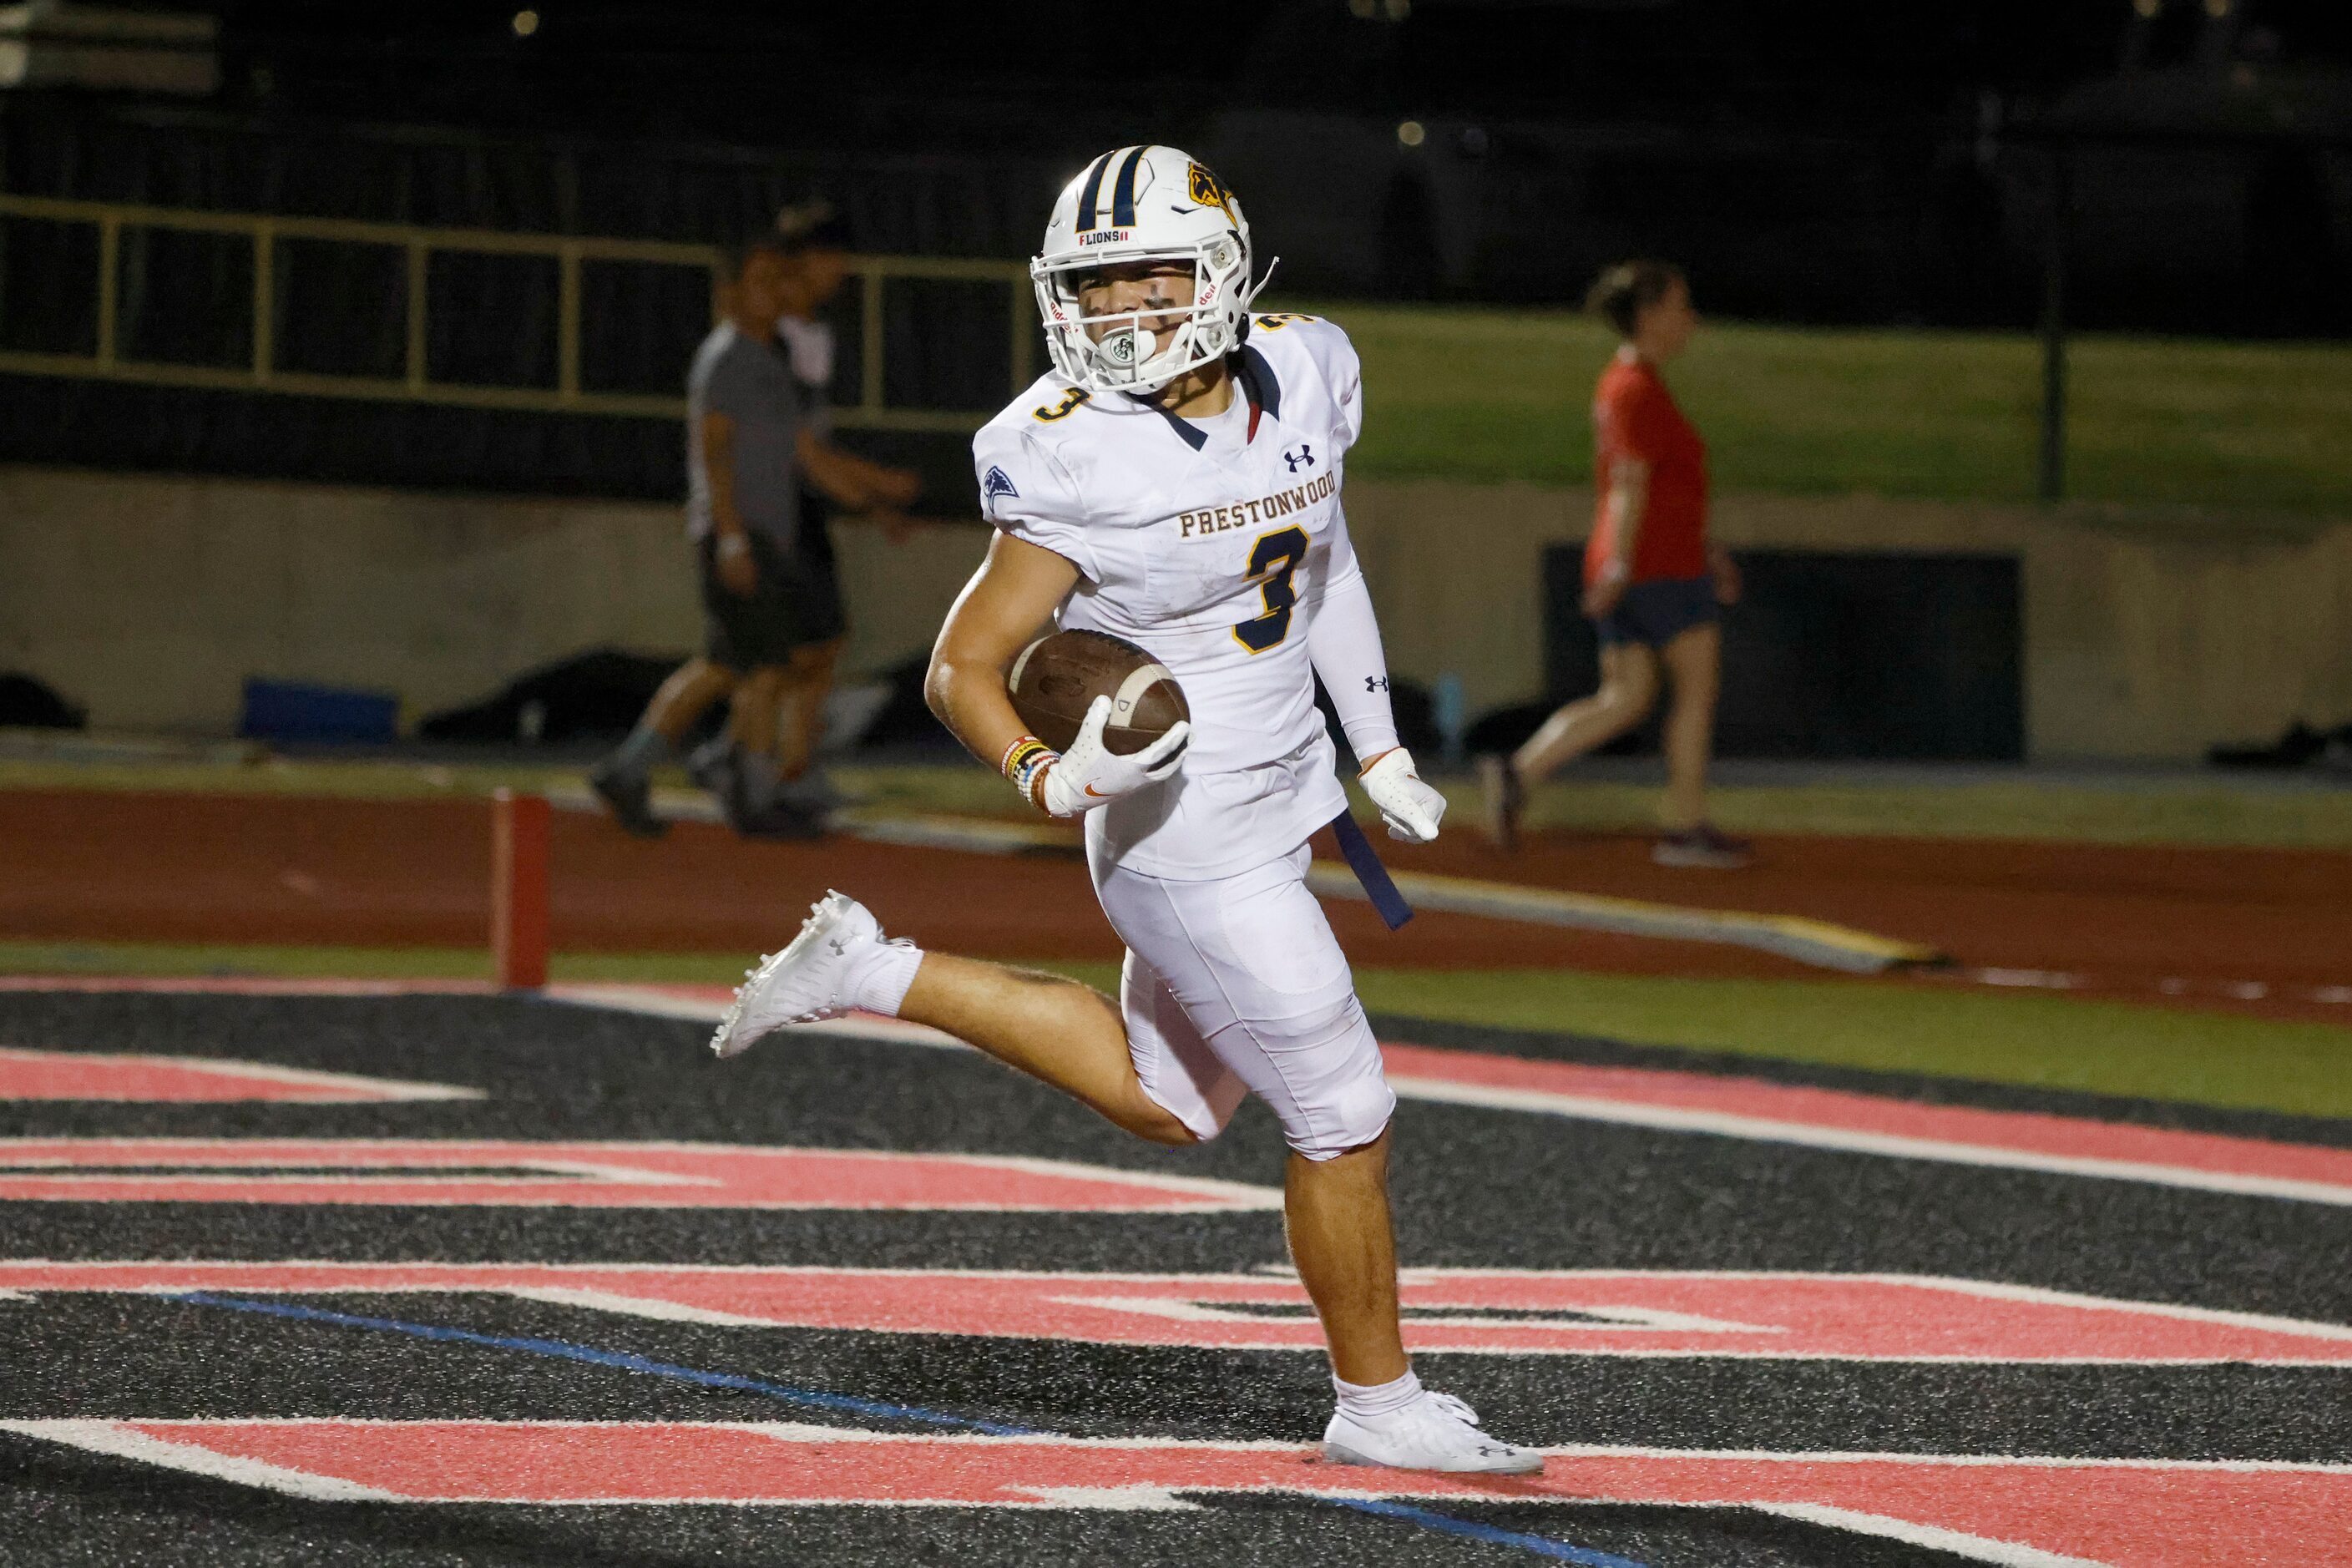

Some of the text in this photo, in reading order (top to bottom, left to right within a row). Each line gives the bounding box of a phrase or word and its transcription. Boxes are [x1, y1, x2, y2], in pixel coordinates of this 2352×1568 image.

[1086, 230, 1120, 245] LIONS
[1031, 387, 1093, 423] 3
[1180, 470, 1336, 538] PRESTONWOOD
[1231, 523, 1311, 655] 3
